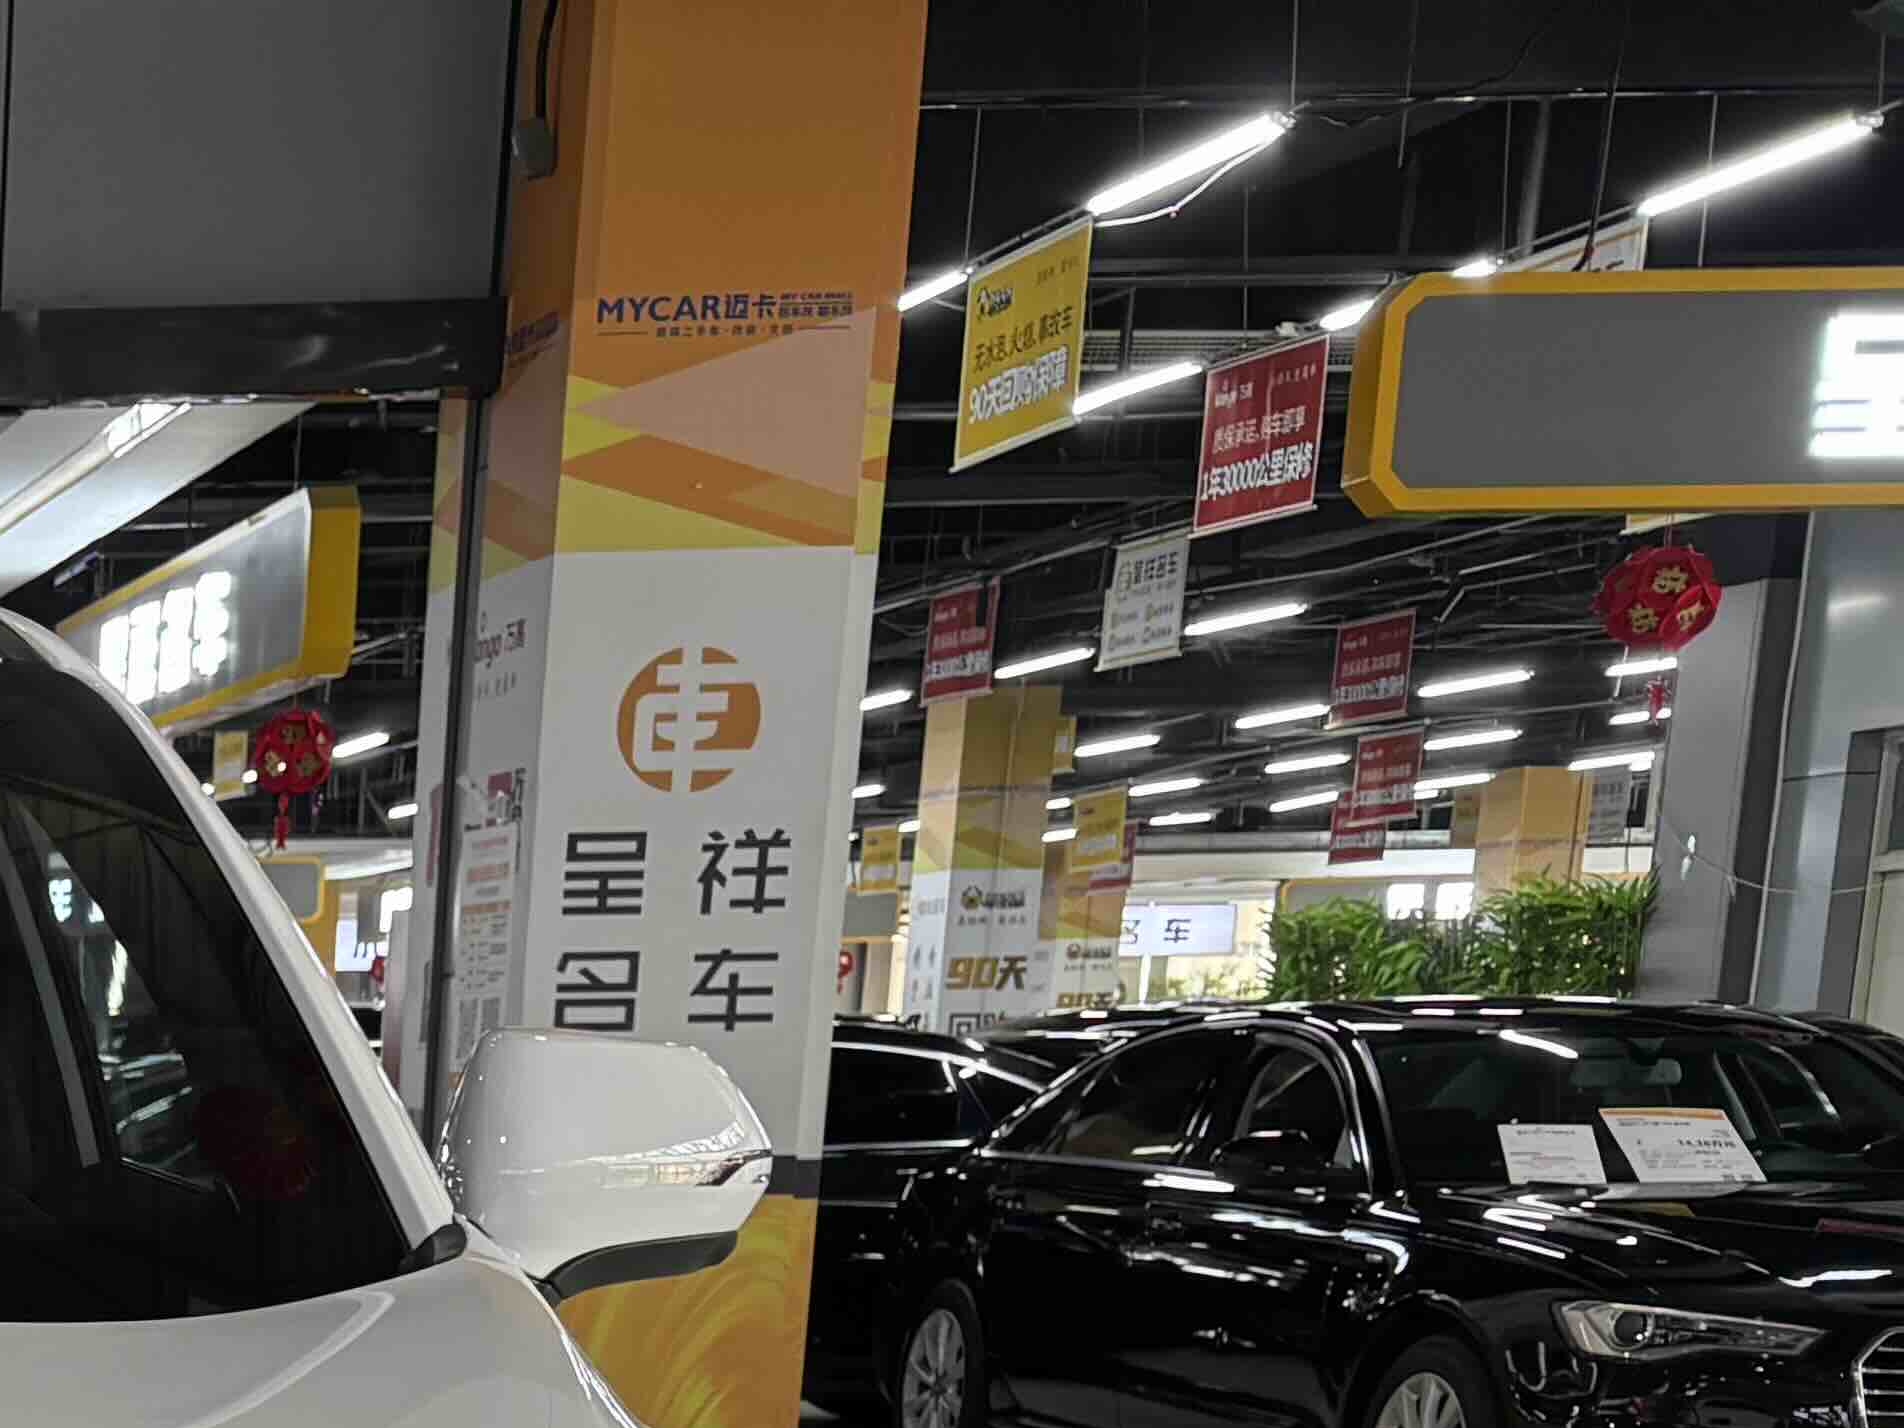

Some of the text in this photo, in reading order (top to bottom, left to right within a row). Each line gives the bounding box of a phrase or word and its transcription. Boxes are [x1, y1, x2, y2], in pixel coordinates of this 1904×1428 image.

[596, 295, 722, 324] MYCAR
[560, 828, 793, 917] 呈祥
[553, 948, 780, 1033] 名车
[945, 955, 1028, 990] 90天
